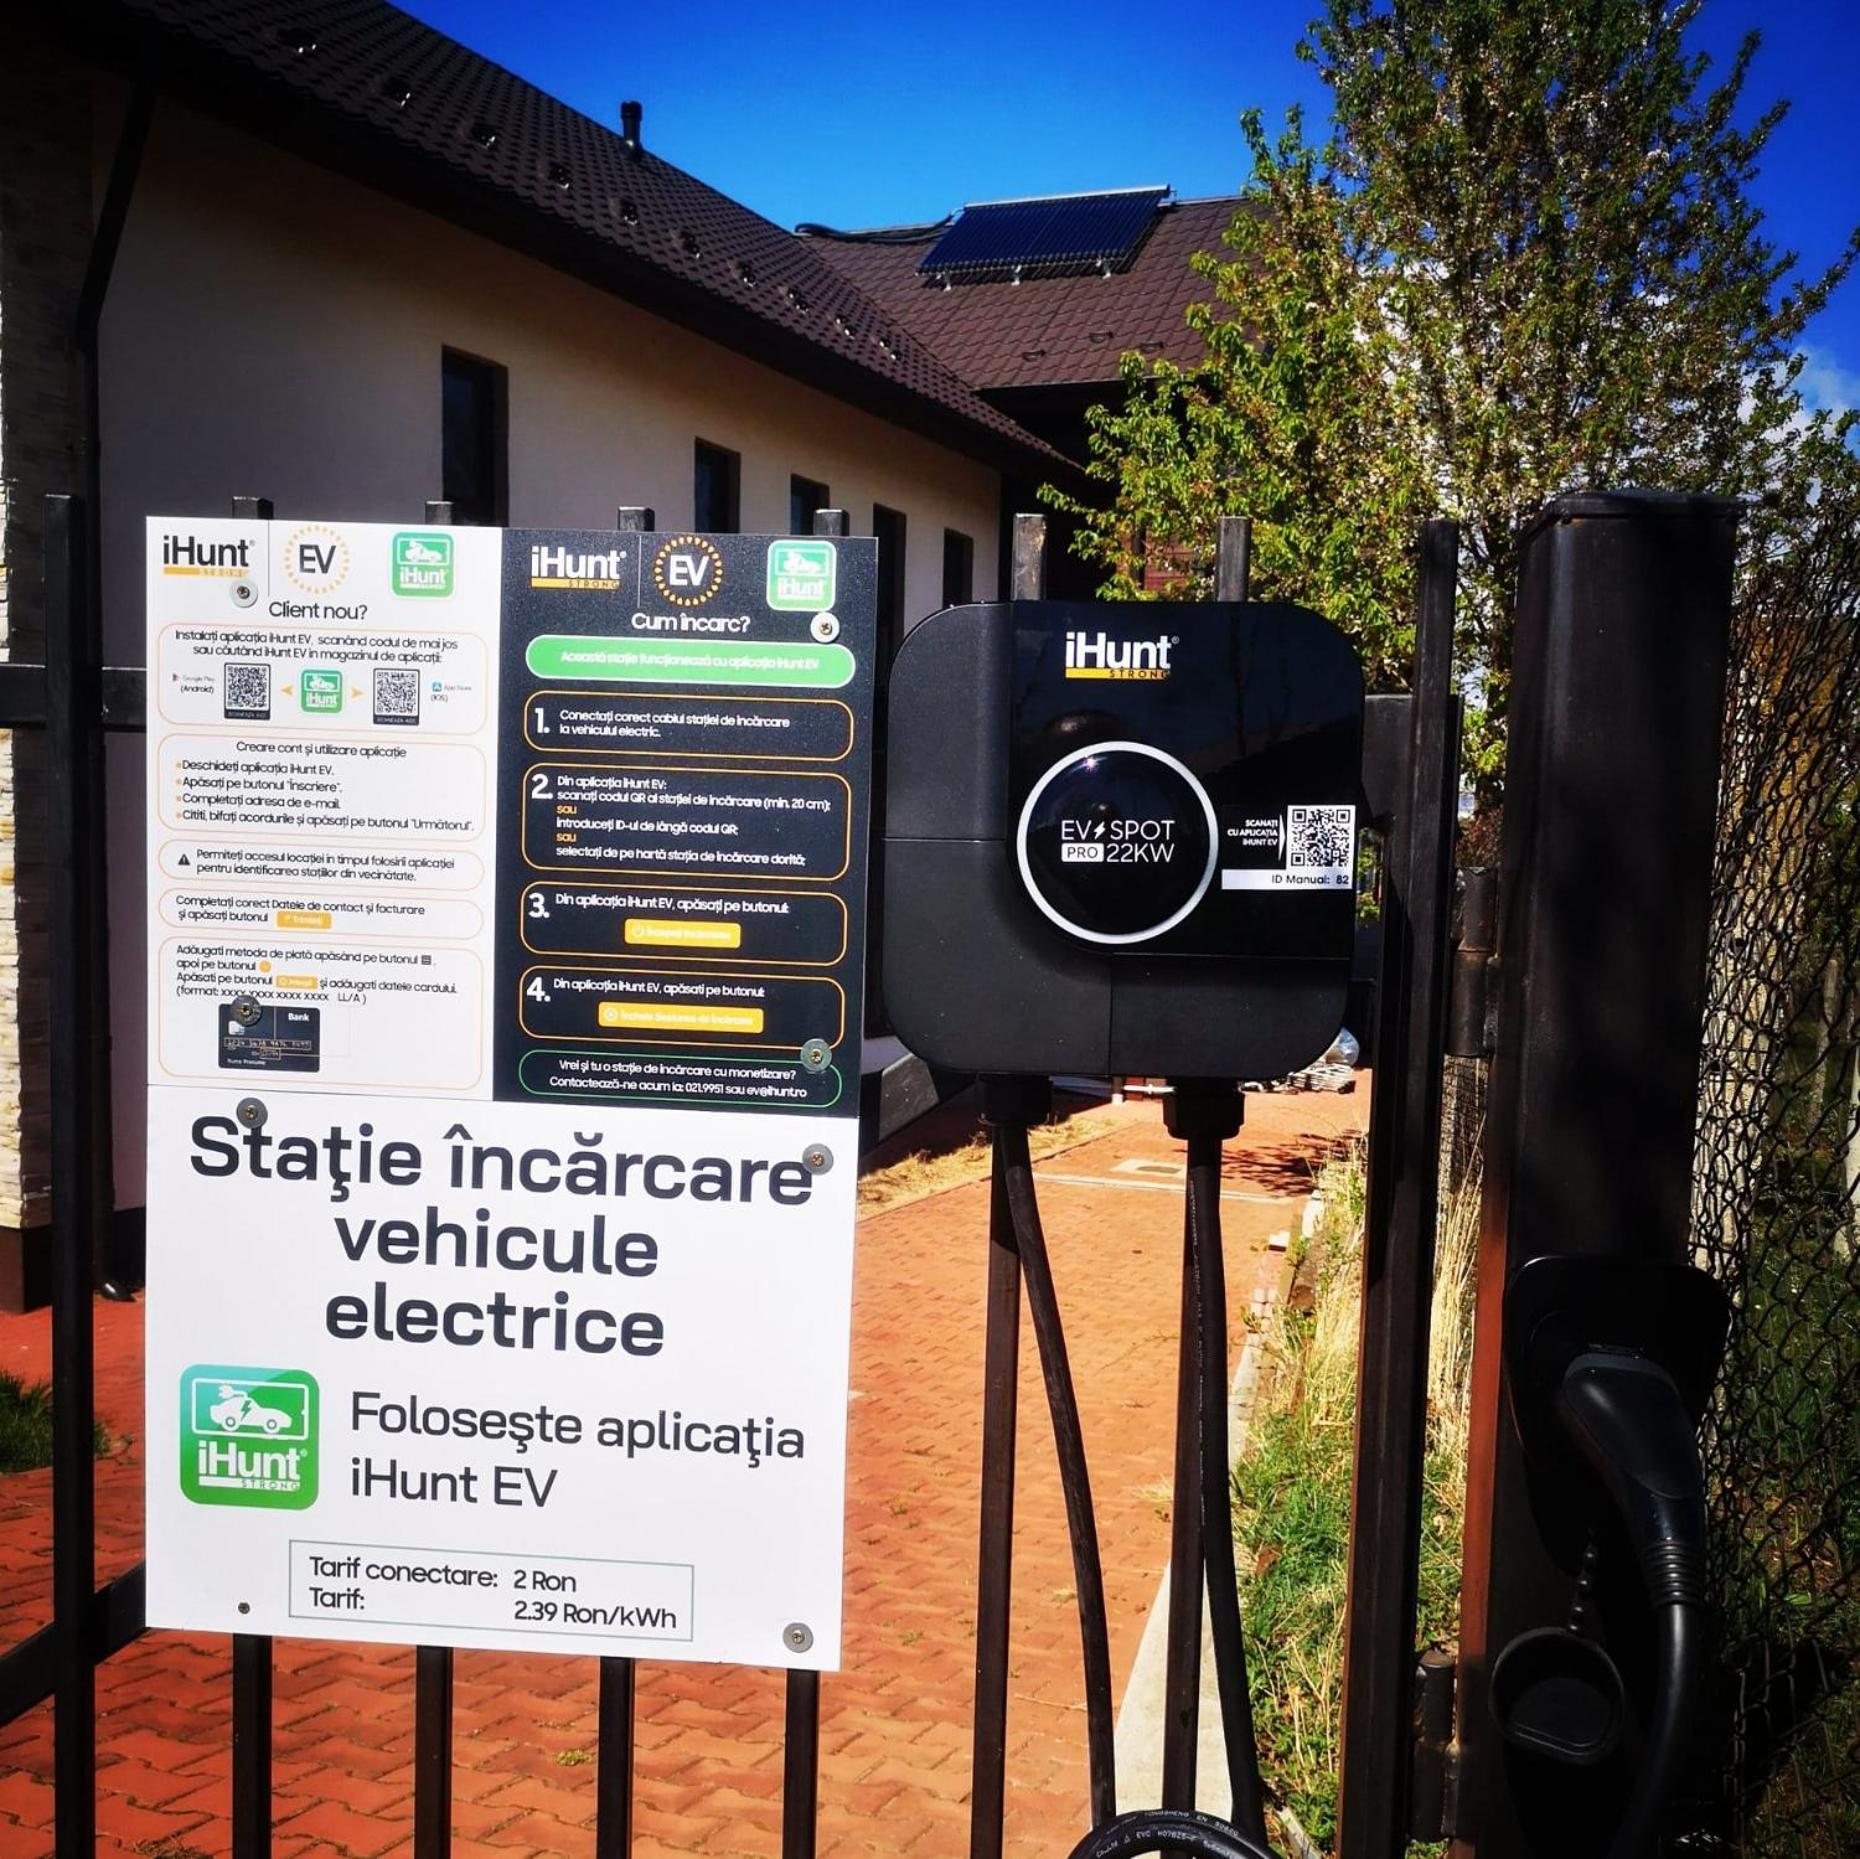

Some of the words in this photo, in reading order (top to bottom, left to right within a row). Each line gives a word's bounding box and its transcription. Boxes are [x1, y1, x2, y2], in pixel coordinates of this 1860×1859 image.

[164, 535, 248, 567] iHunt
[300, 544, 336, 573] EV
[532, 546, 621, 579] iHunt
[670, 555, 710, 586] EV
[269, 601, 319, 617] Client
[324, 605, 367, 620] nou?
[632, 613, 678, 630] Cum
[680, 613, 750, 632] încarc?
[369, 637, 401, 648] codul
[402, 637, 418, 649] de
[419, 638, 441, 650] mai
[442, 638, 459, 652] jos
[1066, 632, 1172, 669] iHunt
[193, 646, 214, 656] sau
[294, 647, 307, 659] EV
[320, 649, 379, 663] magazinul
[380, 650, 396, 662] de
[535, 708, 550, 734] 1.
[720, 714, 736, 727] de
[237, 740, 276, 753] Creare
[278, 743, 303, 754] cont
[315, 744, 357, 756] utilizare
[227, 779, 242, 792] pe
[244, 778, 285, 791] butonul
[558, 774, 575, 787] Din
[245, 796, 285, 807] adresa
[287, 797, 302, 808] de
[599, 791, 630, 803] codul
[693, 794, 709, 806] de
[792, 798, 805, 809] 20
[557, 805, 577, 815] sau
[351, 818, 366, 830] pe
[368, 817, 409, 829] butonul
[640, 820, 655, 832] de
[689, 823, 720, 834] codul
[1061, 820, 1092, 840] EV
[1110, 820, 1176, 840] SPOT
[556, 832, 577, 843] sau
[245, 852, 285, 862] accesul
[338, 855, 370, 868] timpul
[604, 847, 618, 858] de
[620, 849, 635, 861] pe
[700, 850, 715, 862] de
[1066, 846, 1098, 858] PRO
[1106, 842, 1175, 863] 22KW
[197, 864, 232, 875] pentru
[234, 863, 299, 877] identificarea
[341, 868, 357, 879] din
[1272, 875, 1282, 884] ID
[1286, 875, 1330, 884] Manual:
[1336, 875, 1349, 885] 82
[236, 899, 270, 909] corect
[307, 901, 322, 911] de
[324, 903, 365, 913] contact
[376, 903, 426, 915] facturare
[528, 893, 550, 918] 3.
[556, 892, 575, 905] Din
[724, 901, 741, 915] pe
[229, 911, 269, 923] butonul
[177, 958, 200, 971] apoi
[202, 960, 217, 972] pe
[218, 960, 257, 971] butonul
[226, 947, 268, 958] metoda
[270, 949, 284, 959] de
[363, 954, 378, 965] pe
[379, 953, 419, 965] butonul
[218, 975, 233, 986] pe
[234, 974, 273, 986] butonul
[526, 976, 551, 1002] 4.
[554, 977, 571, 989] Din
[706, 986, 721, 998] pe
[559, 1059, 580, 1071] Vrei
[591, 1061, 602, 1072] tu
[603, 1063, 611, 1072] o
[644, 1063, 659, 1074] de
[715, 1068, 728, 1077] cu
[729, 1067, 797, 1080] monetizare?
[639, 1081, 671, 1092] acum
[726, 1085, 745, 1095] sau
[442, 1122, 814, 1206] încărcare
[333, 1206, 660, 1278] vehicule
[325, 1280, 665, 1358] electrice
[198, 1440, 300, 1480] iHunt
[242, 1480, 300, 1492] STRONG
[350, 1456, 478, 1504] iHunt
[494, 1466, 558, 1508] EV
[310, 1556, 361, 1579] Tarif
[366, 1561, 499, 1588] conectare:
[514, 1570, 526, 1590] 2
[532, 1571, 577, 1594] Ron
[309, 1587, 365, 1610] Tarif:
[514, 1600, 558, 1622] 2.39
[564, 1602, 677, 1629] Ron/kWh
